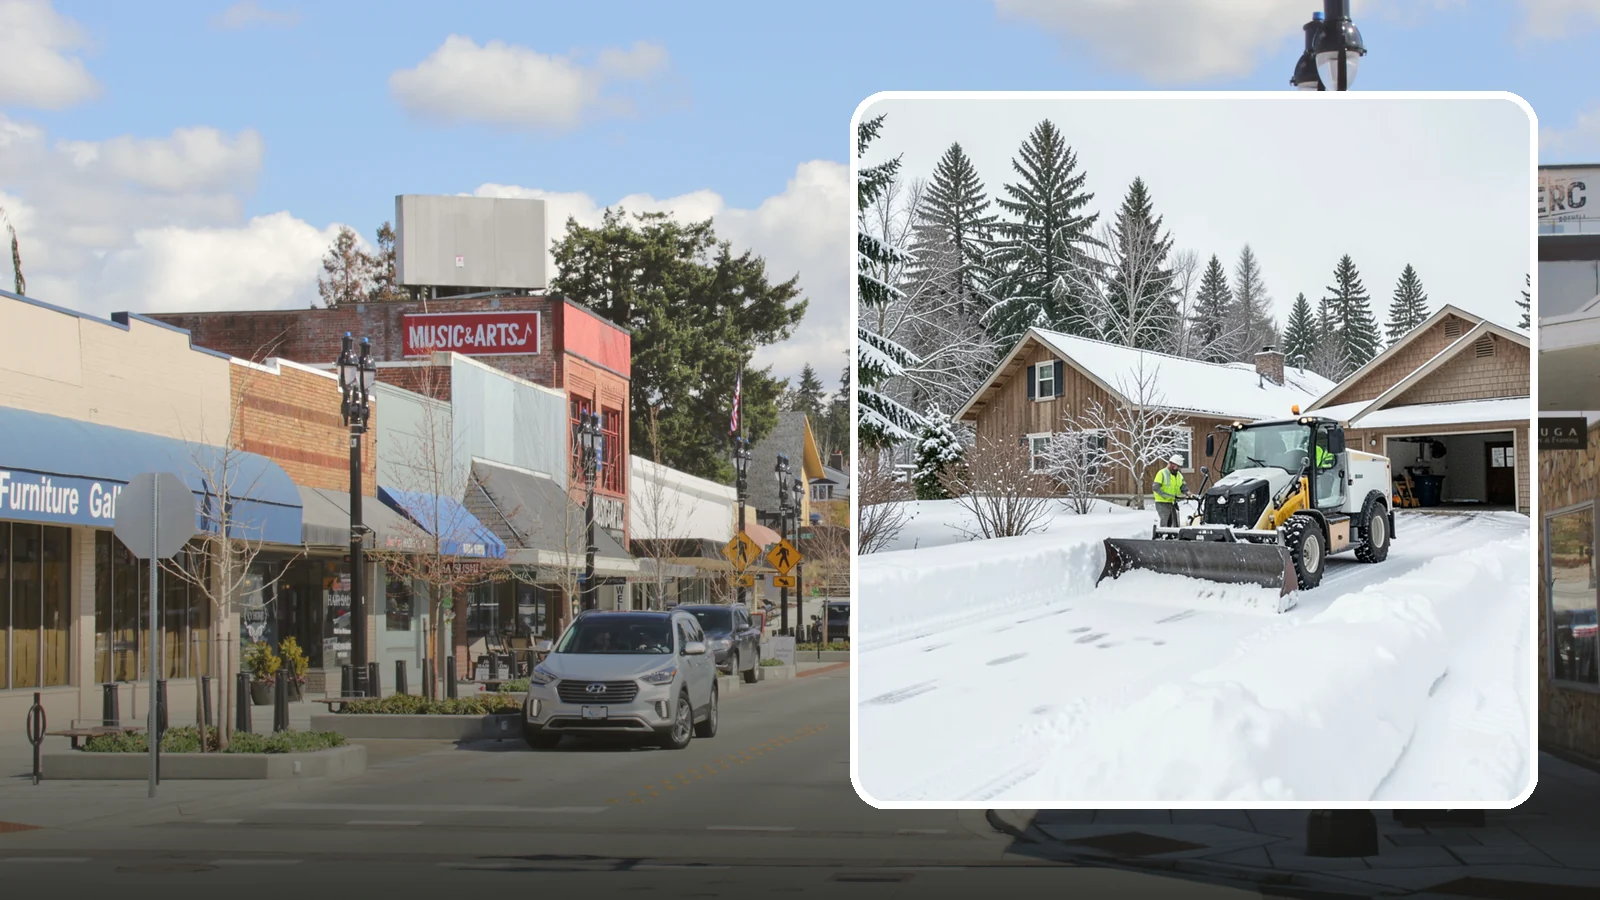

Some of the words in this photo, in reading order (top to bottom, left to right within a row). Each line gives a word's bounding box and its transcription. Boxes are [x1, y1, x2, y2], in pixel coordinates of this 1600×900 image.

[1540, 427, 1577, 436] UGA
[0, 472, 79, 515] Furniture
[453, 562, 479, 574] SUSHI
